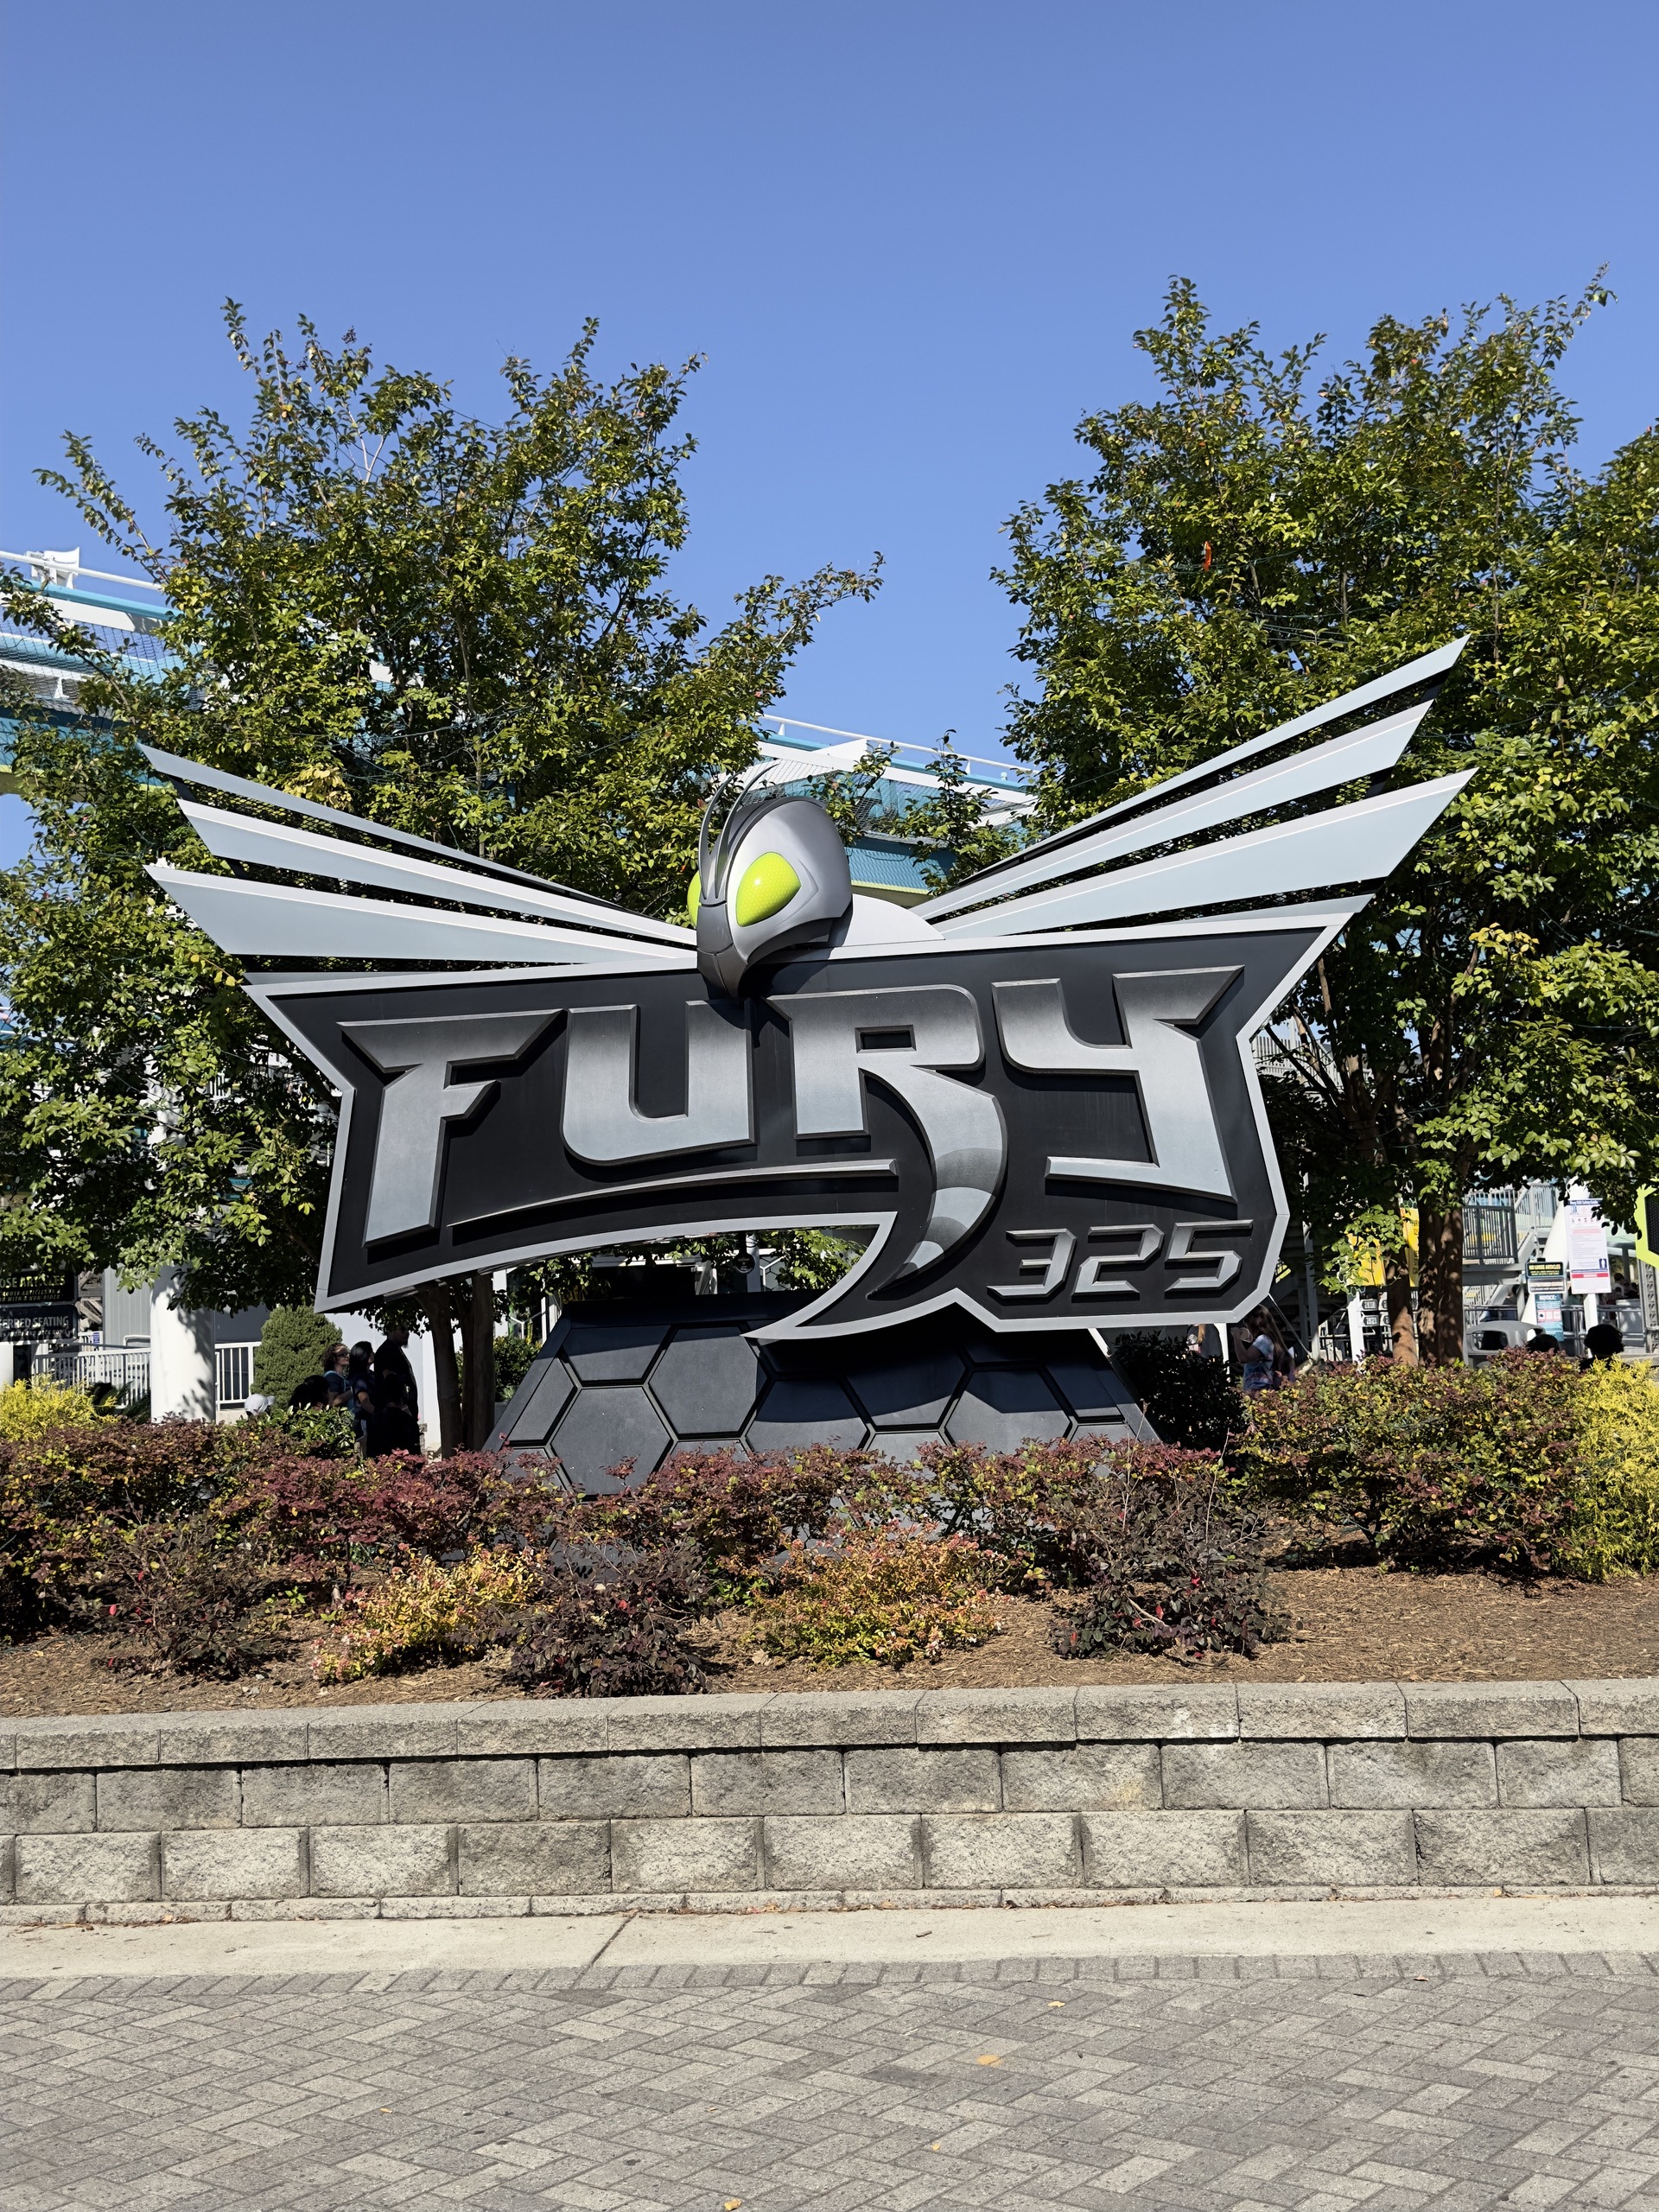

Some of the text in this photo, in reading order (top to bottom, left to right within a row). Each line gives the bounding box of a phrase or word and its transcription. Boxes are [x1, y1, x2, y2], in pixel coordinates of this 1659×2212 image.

[337, 965, 1245, 1300] FURY
[987, 1219, 1253, 1298] 325
[32, 1316, 69, 1328] SEATING
